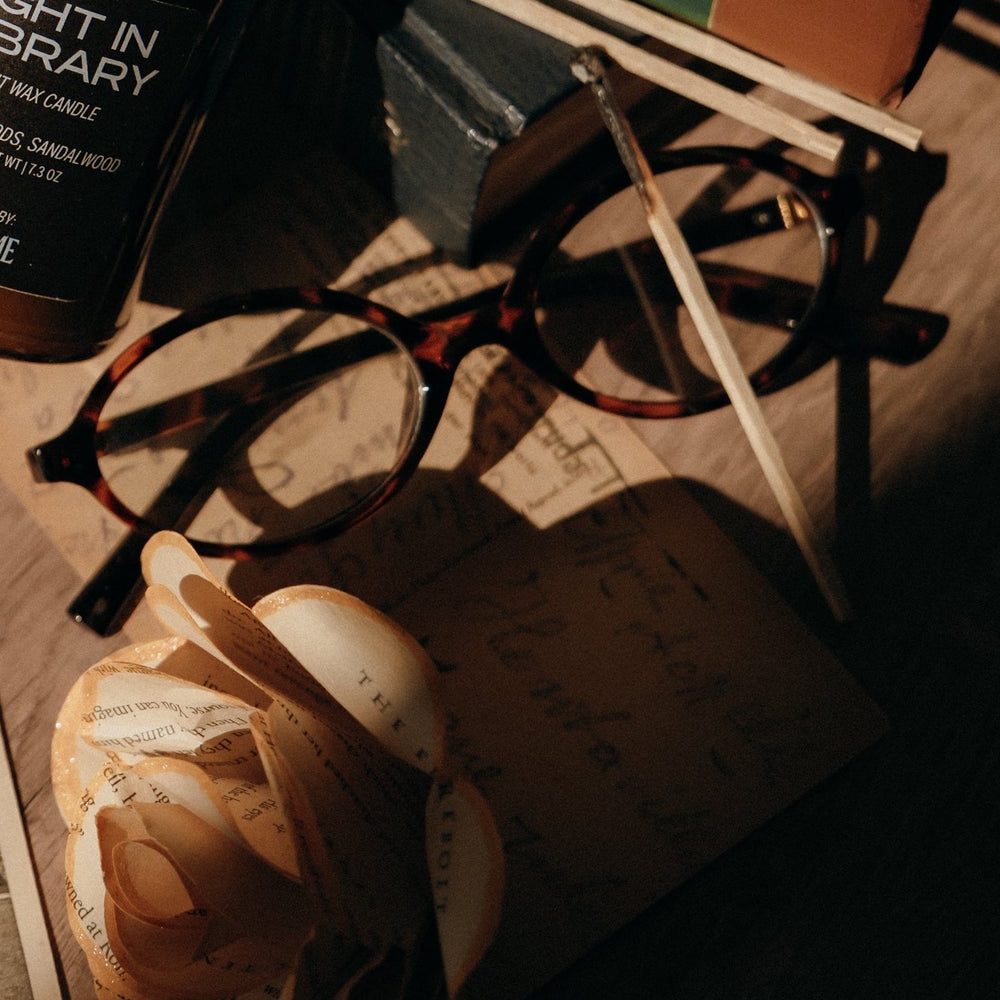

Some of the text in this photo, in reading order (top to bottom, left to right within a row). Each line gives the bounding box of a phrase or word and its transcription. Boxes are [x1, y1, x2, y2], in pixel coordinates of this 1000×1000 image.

[110, 21, 160, 59] IN
[9, 77, 47, 104] WAX
[43, 93, 102, 122] CANDLE
[27, 136, 121, 173] SANDALWOOD
[27, 162, 46, 181] 7.3
[45, 169, 64, 184] OZ
[135, 700, 160, 712] can
[160, 700, 187, 719] You
[358, 669, 407, 732] THE
[113, 723, 176, 746] named
[85, 921, 104, 940] at
